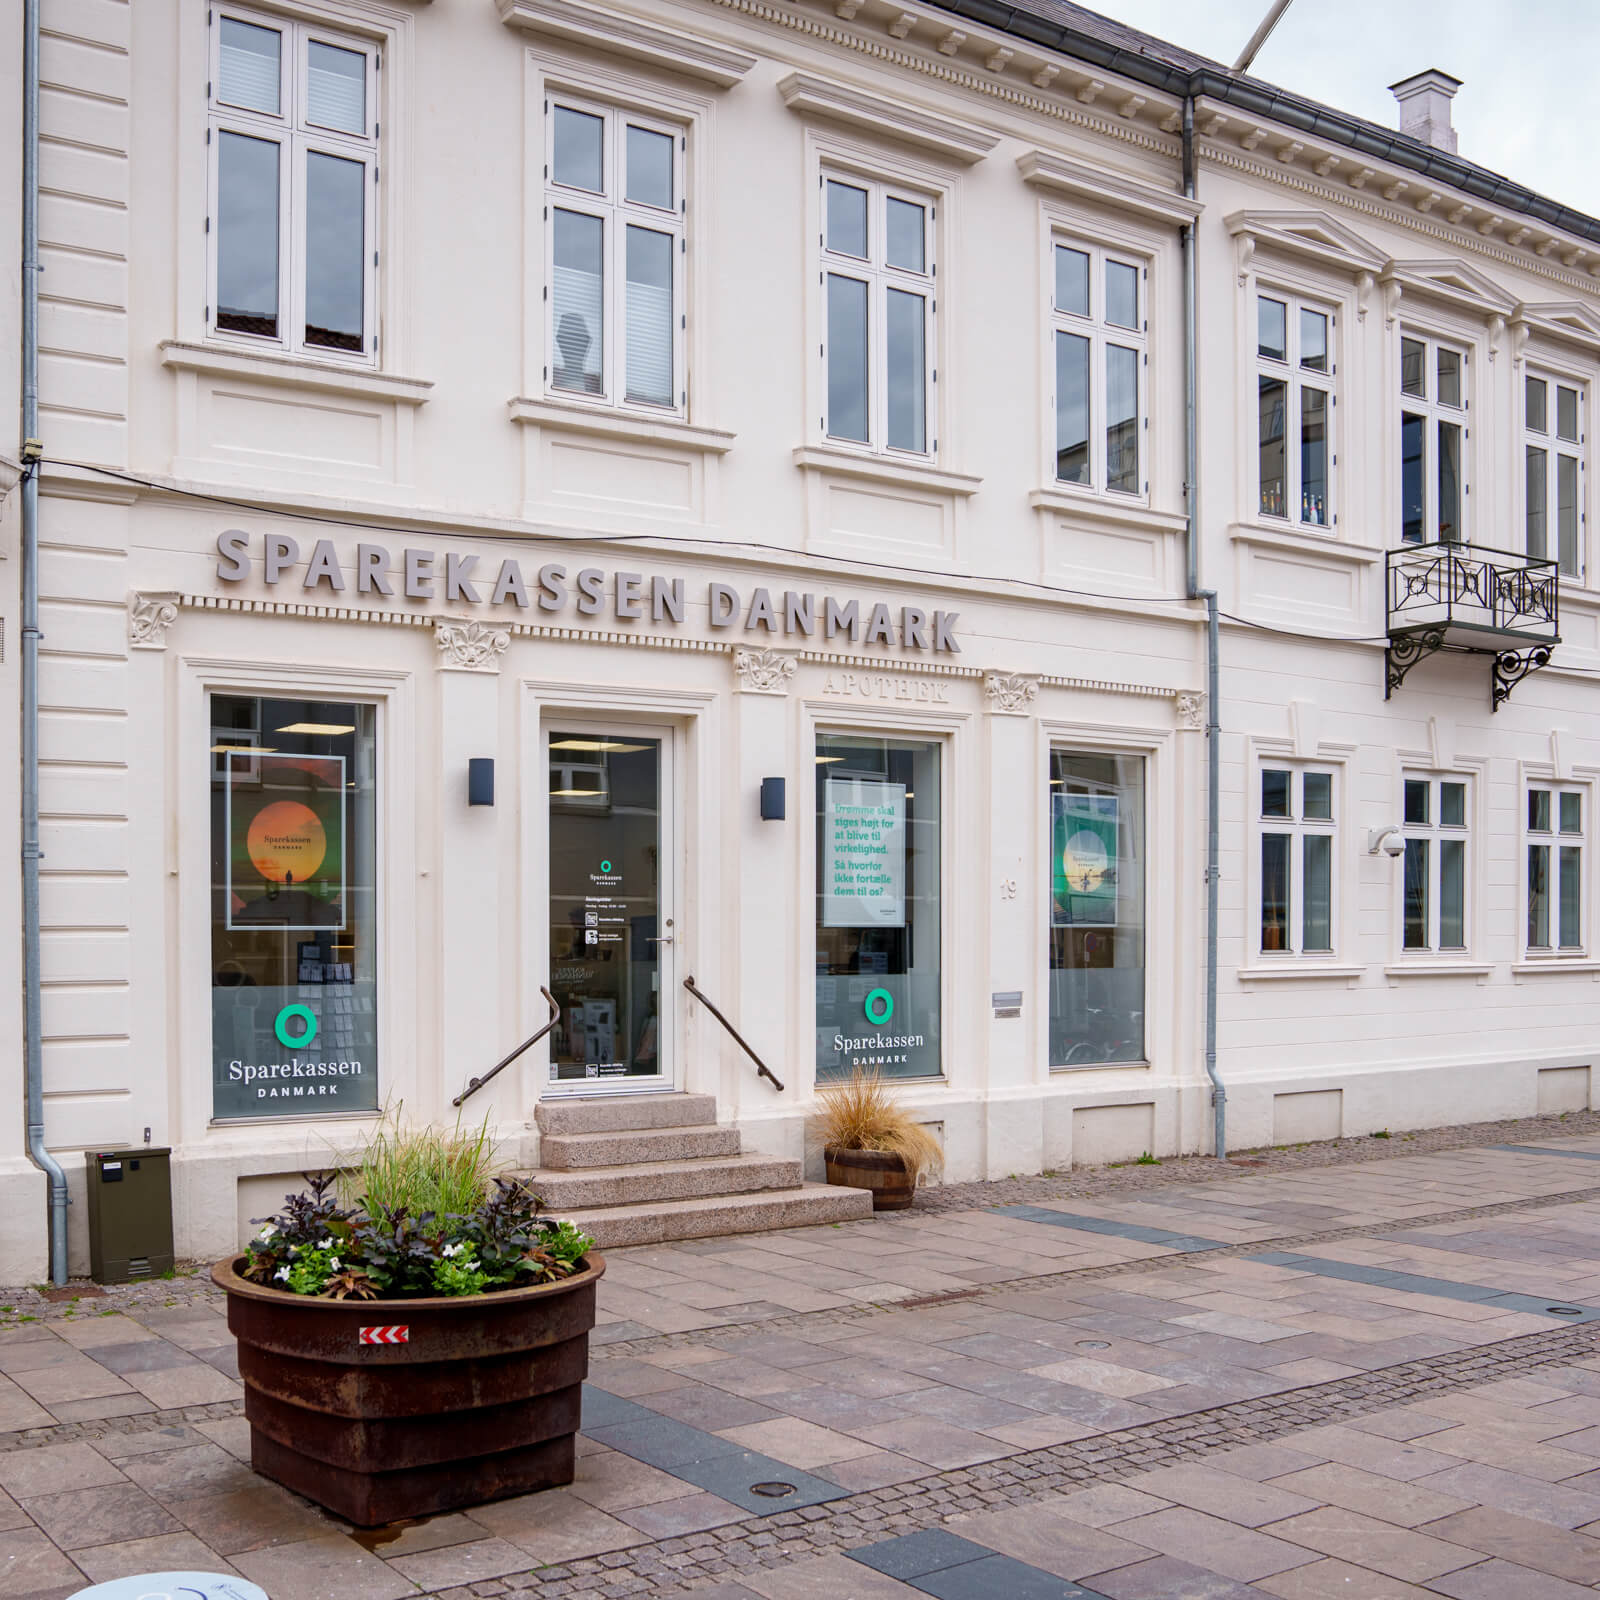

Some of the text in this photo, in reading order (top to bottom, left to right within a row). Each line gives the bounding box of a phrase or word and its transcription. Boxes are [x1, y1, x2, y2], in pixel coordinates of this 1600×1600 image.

[216, 529, 961, 653] SPAREKASSEN DANMARK
[822, 672, 949, 704] APOTHEK
[877, 806, 895, 816] skal
[834, 818, 894, 830] siges højt for
[834, 831, 881, 841] at blive til
[834, 844, 888, 855] virkelighed.
[834, 859, 882, 871] Så hvorfor
[834, 873, 892, 884] ikke fortælle
[834, 886, 883, 897] dem til os?
[834, 1033, 924, 1054] Sparekassen
[853, 1055, 907, 1066] DANMARK
[229, 1058, 362, 1085] Sparekassen
[257, 1085, 338, 1098] DANMARK
